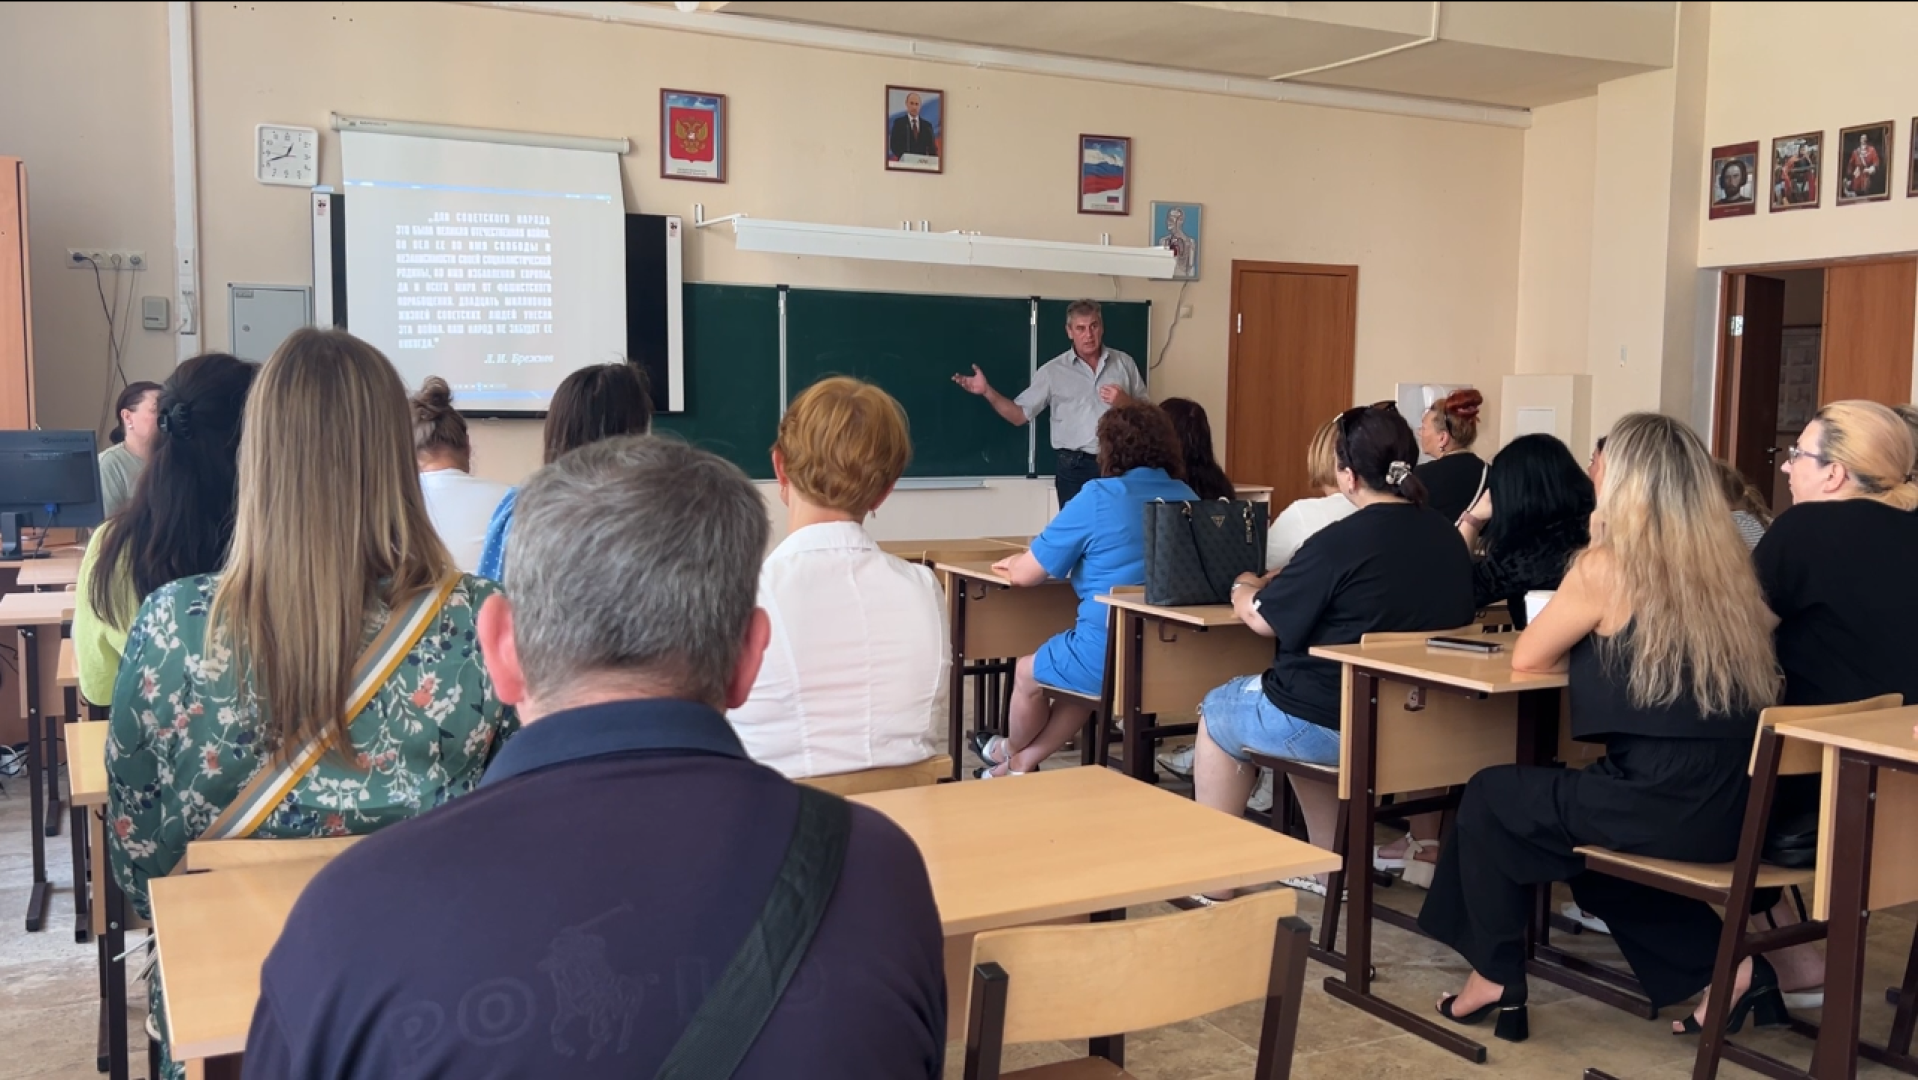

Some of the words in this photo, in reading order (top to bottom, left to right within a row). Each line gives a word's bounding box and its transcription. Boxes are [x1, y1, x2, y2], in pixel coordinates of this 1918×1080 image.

[456, 211, 510, 224] СОВЕТСКОГО
[517, 214, 551, 225] НАРОДА
[396, 224, 410, 235] ЭТО
[494, 241, 539, 252] СВОБОДЫ
[397, 282, 408, 292] ДА
[482, 282, 491, 292] ОТ
[497, 283, 552, 293] ФАШИСТСКОГО
[459, 296, 500, 307] ДВАДЦАТЬ
[505, 296, 552, 306] МИЛЛИОНОВ
[437, 310, 482, 320] СОВЕТСКИХ
[488, 309, 517, 321] ЛЮДЕЙ
[524, 310, 552, 320] УНЕСЛА
[398, 324, 412, 334] ЭТА
[468, 324, 493, 334] НАРОД
[509, 324, 540, 334] ЗАБУДЕТ
[511, 353, 554, 366] Брежнев
